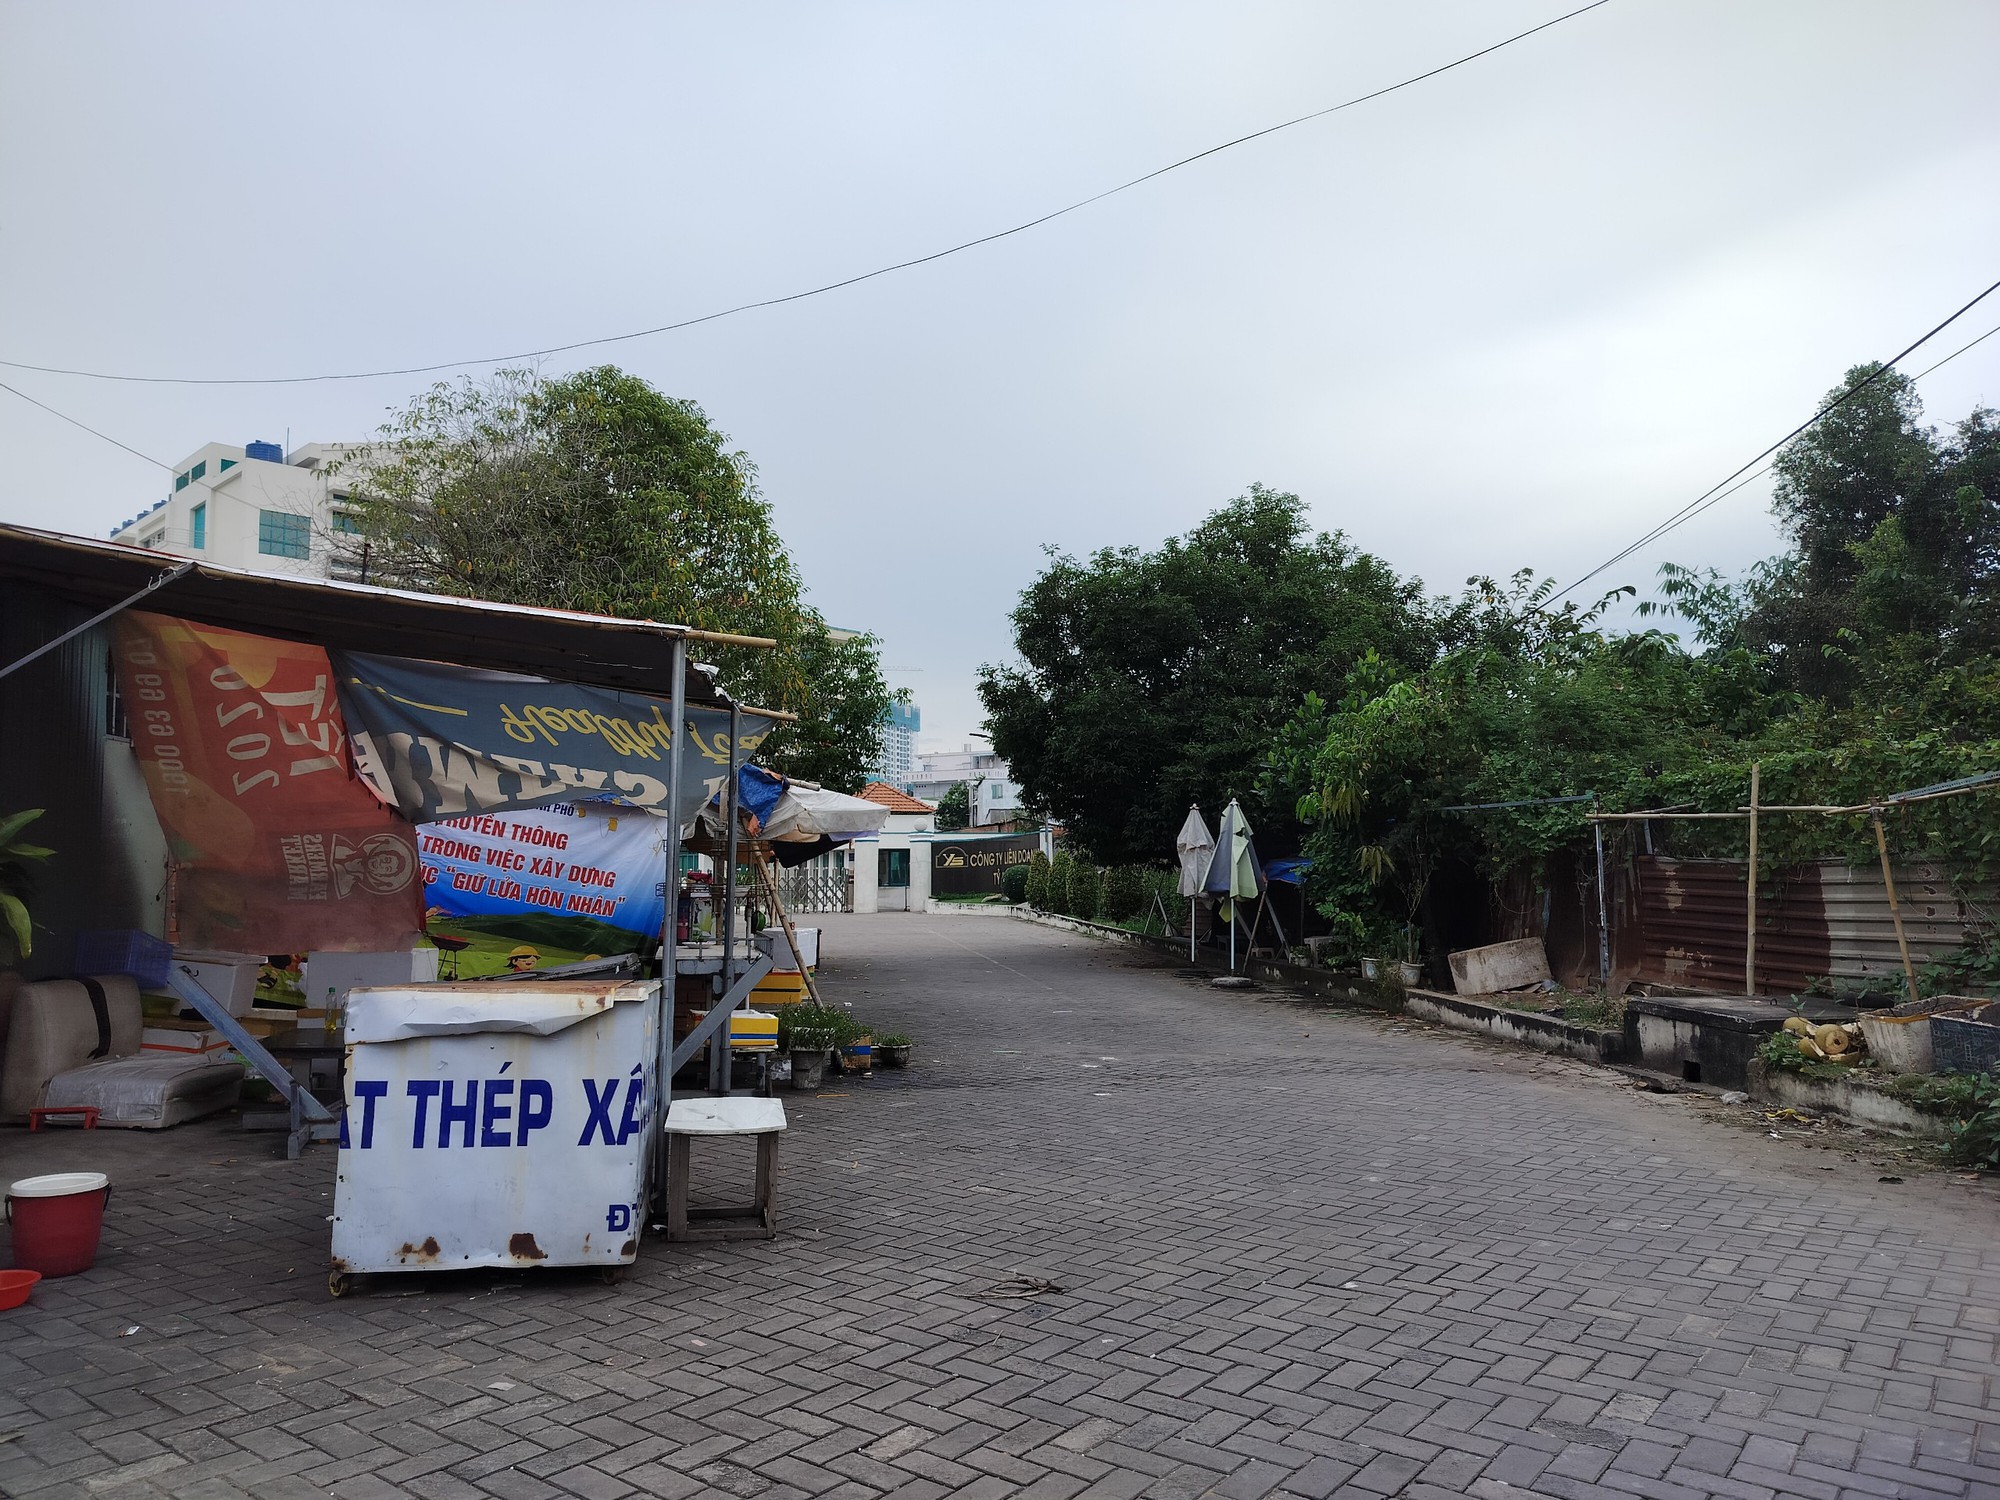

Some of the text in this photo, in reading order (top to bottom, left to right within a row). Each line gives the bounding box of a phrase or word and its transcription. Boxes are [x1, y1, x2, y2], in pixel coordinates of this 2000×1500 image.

[552, 802, 576, 816] PHỐ
[511, 823, 569, 850] THÔNG
[422, 835, 617, 888] TRONG VIỆC XÂY DỰNG
[970, 851, 995, 866] CÔNG
[996, 853, 1003, 864] TY
[1004, 848, 1017, 864] LIÊN
[488, 875, 521, 901] LỬA
[526, 885, 564, 907] HÔN
[407, 1061, 553, 1148] THÉP
